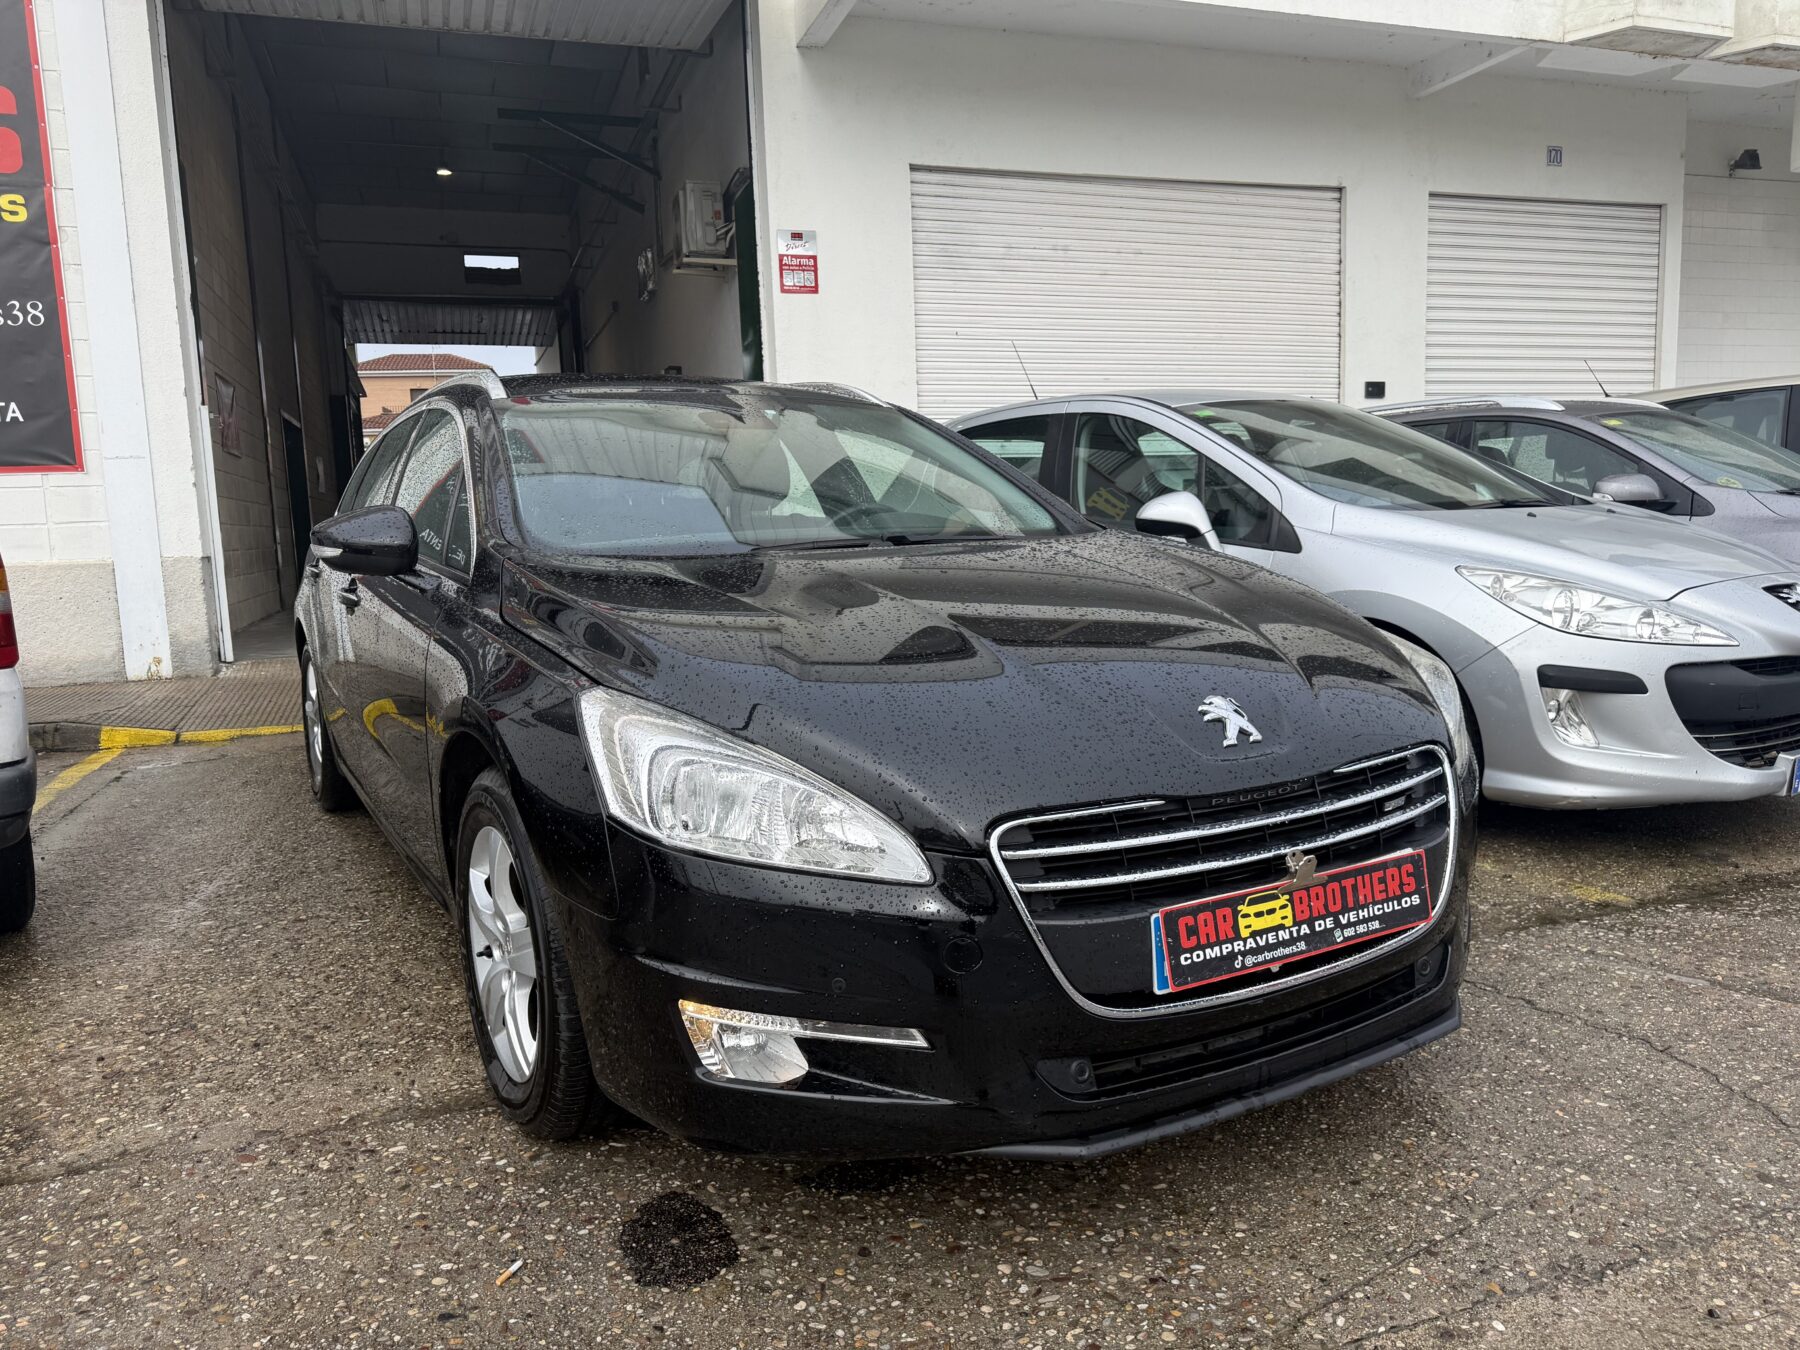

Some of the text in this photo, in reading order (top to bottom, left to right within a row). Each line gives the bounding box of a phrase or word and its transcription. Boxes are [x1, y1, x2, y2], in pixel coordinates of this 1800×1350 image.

[783, 256, 814, 266] Alarma
[1212, 783, 1302, 806] PEUGEOT
[1178, 863, 1416, 949] CAR BROTHERS
[1180, 894, 1421, 966] COMPRAVENTA DE VEHÍCULOS
[1368, 920, 1380, 931] 538
[1244, 941, 1306, 966] @carbrothers38
